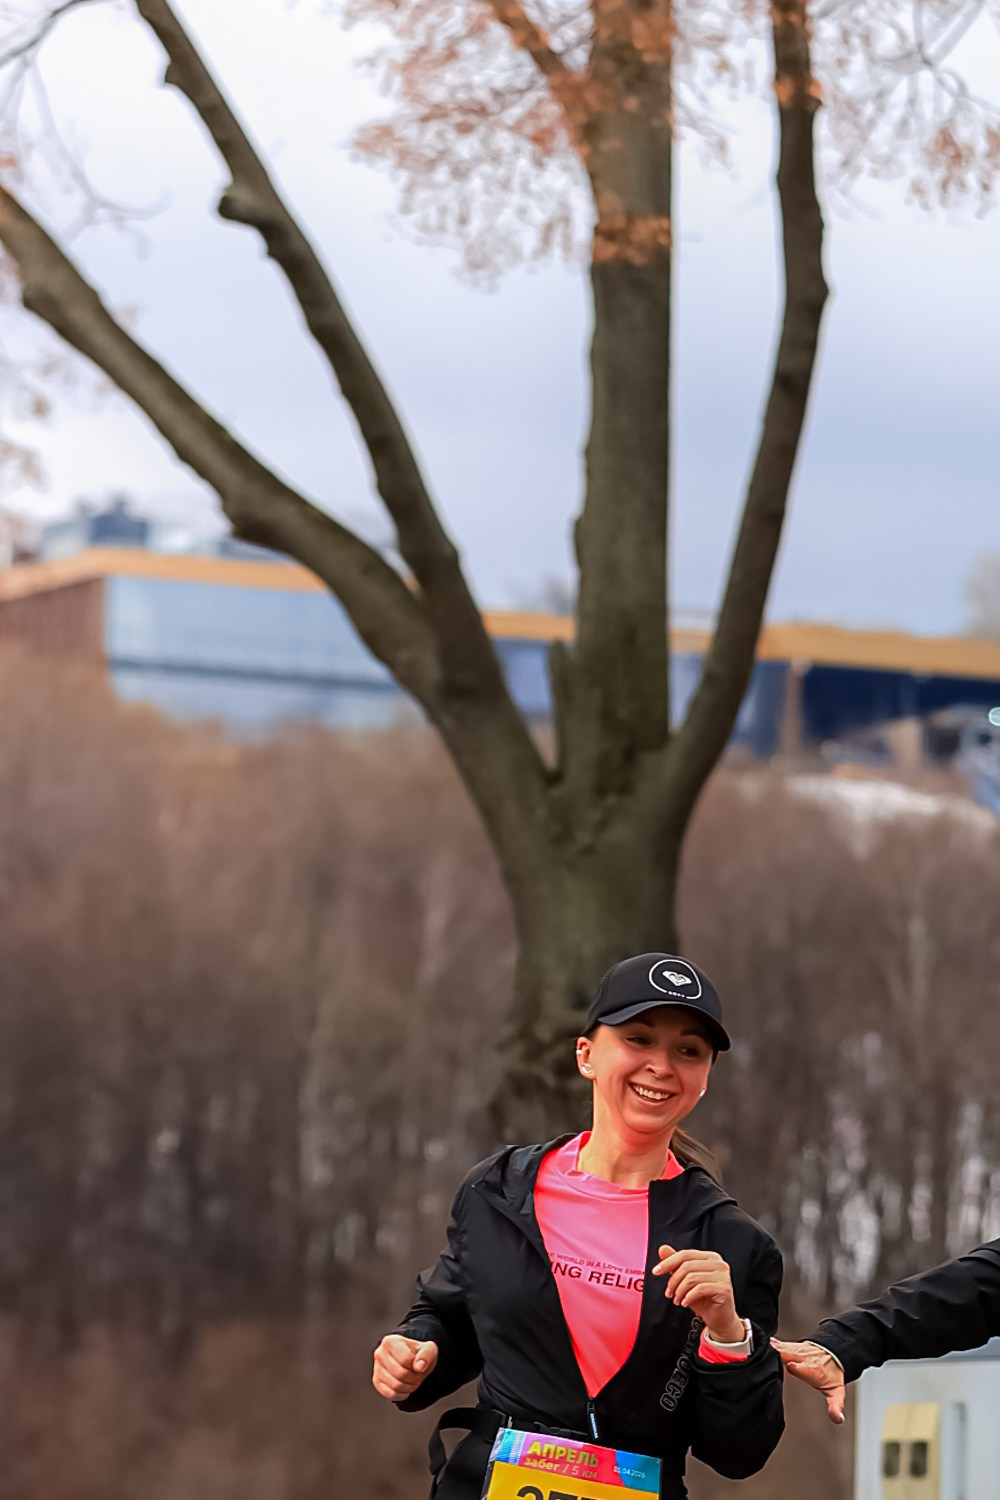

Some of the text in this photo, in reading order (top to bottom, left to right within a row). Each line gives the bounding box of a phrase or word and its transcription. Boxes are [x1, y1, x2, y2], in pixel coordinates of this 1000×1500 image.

[557, 1253, 585, 1265] WORLD
[527, 1441, 598, 1468] АПРЕЛЬ
[524, 1457, 560, 1471] забег
[572, 1465, 580, 1476] 5
